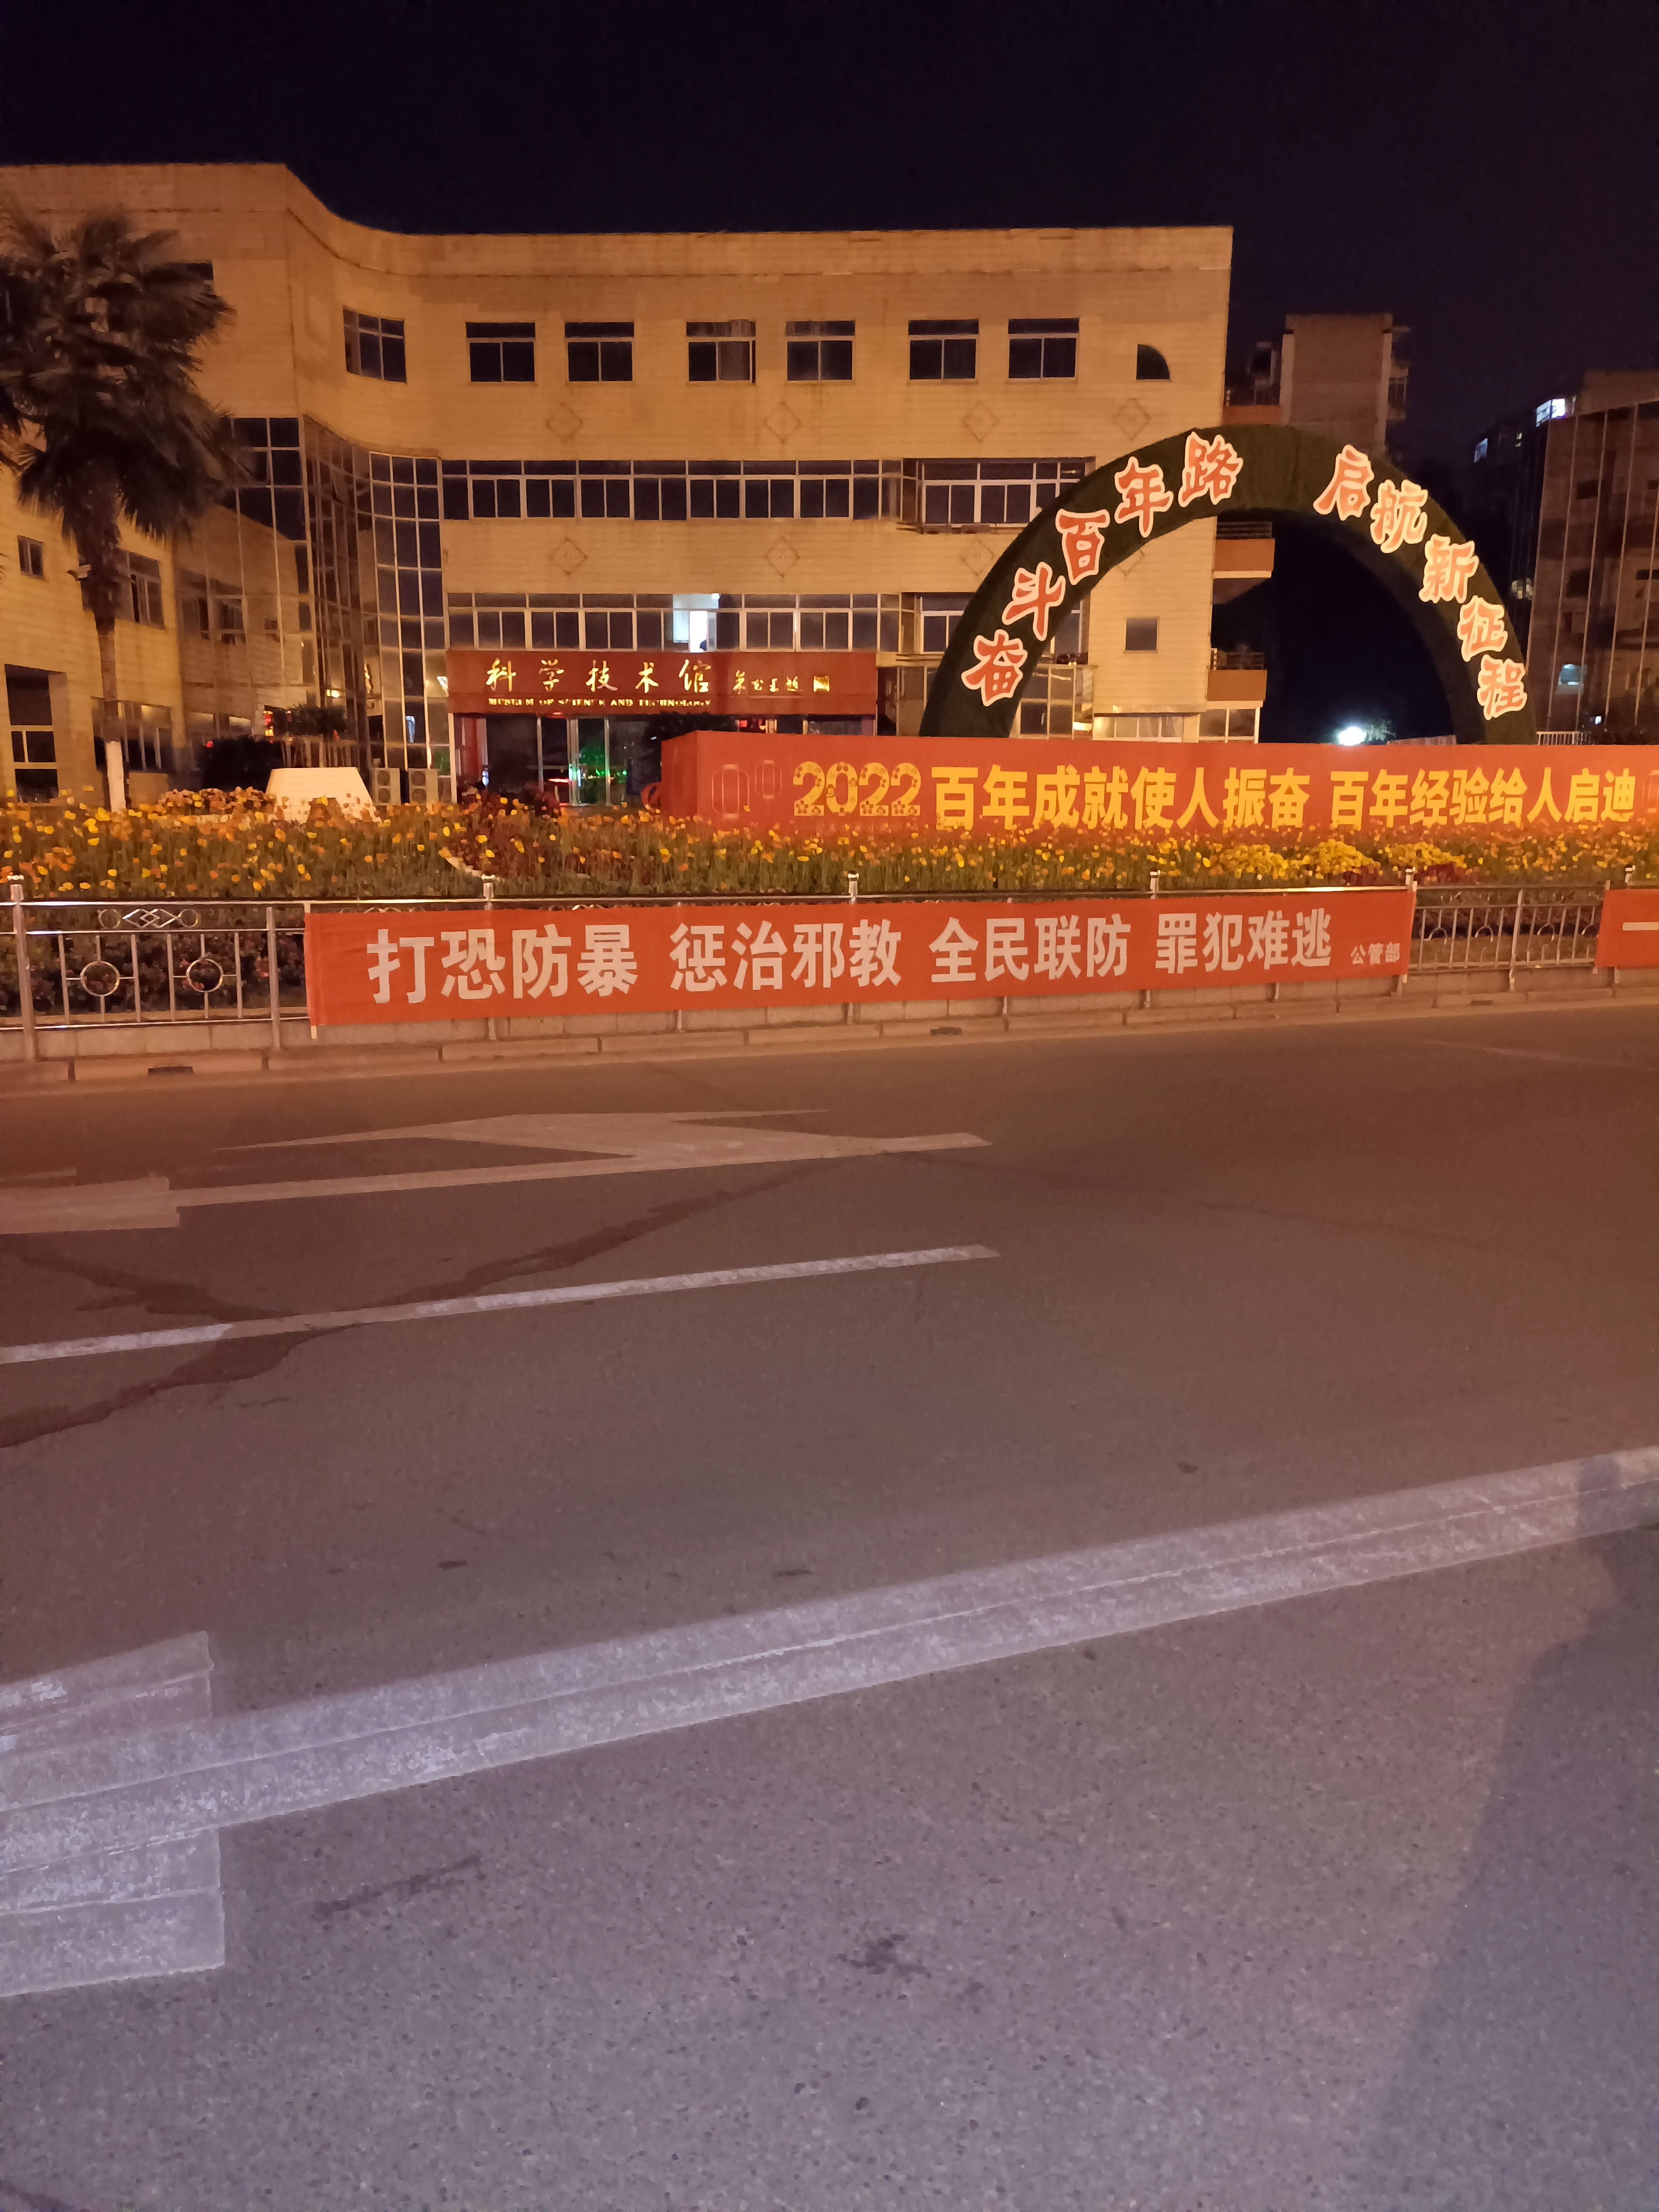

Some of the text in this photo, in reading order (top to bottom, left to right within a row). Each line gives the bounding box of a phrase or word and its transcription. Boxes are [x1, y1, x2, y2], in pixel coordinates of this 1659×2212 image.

[961, 432, 1243, 706] 奋斗百年路
[1314, 445, 1527, 720] 启航新征程
[486, 658, 711, 693] 科学技术馆
[793, 761, 1636, 830] 2022 百年成就使人振奋 百年经验给人启迪
[366, 923, 639, 1004] 打恐防暴
[669, 919, 902, 992] 惩治邪教
[928, 914, 1132, 983] 全民联防
[1154, 907, 1332, 975] 罪犯难逃
